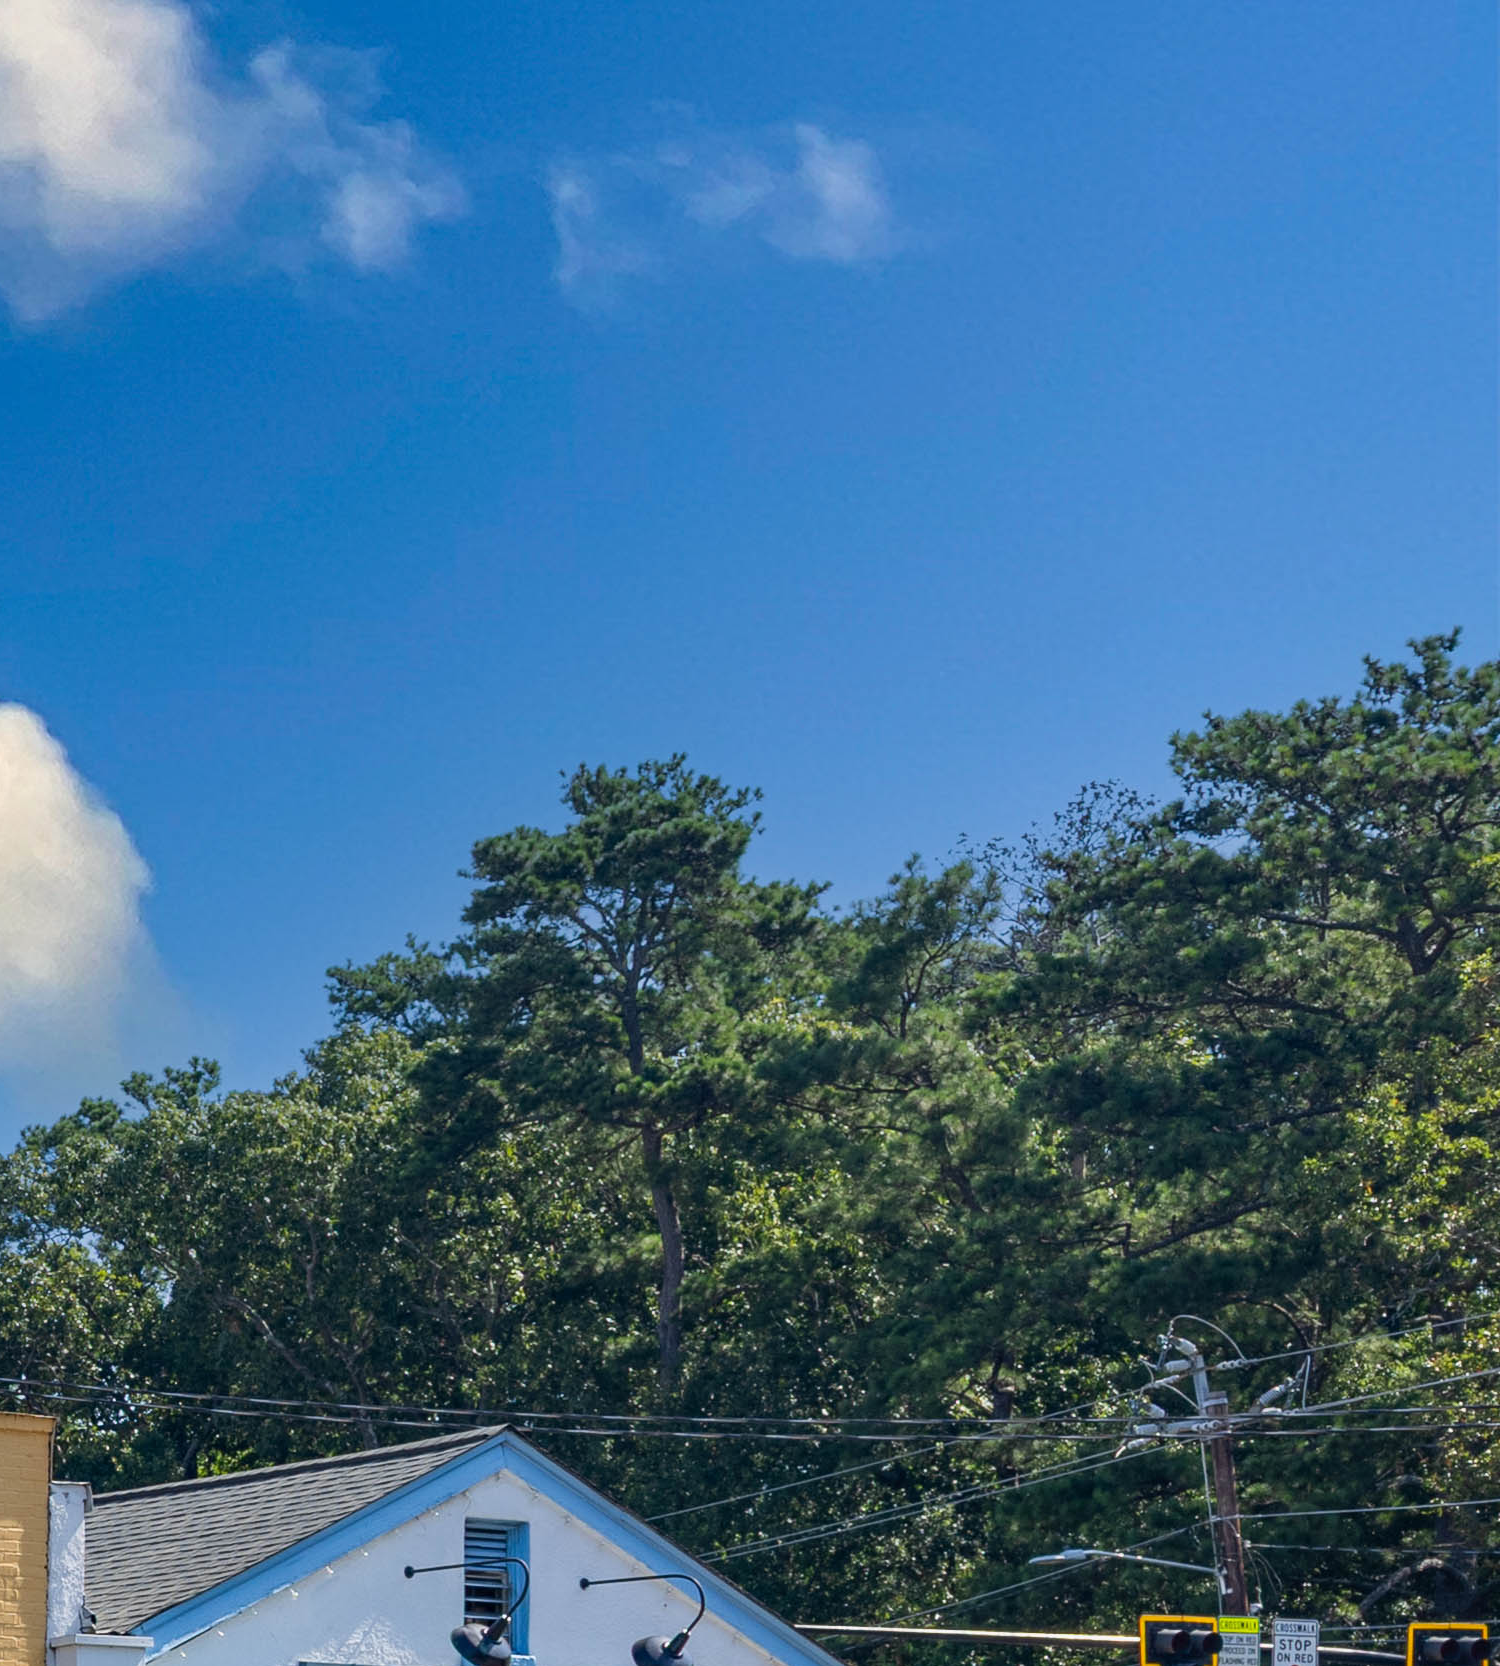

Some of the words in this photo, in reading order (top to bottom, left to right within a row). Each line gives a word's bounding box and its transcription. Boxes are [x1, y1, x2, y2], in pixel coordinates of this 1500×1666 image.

[1220, 1621, 1257, 1631] CROSSWALK
[1275, 1623, 1315, 1633] CROSSWALK
[1279, 1640, 1312, 1651] STOP
[1277, 1653, 1291, 1662] ON
[1294, 1654, 1314, 1664] RED
